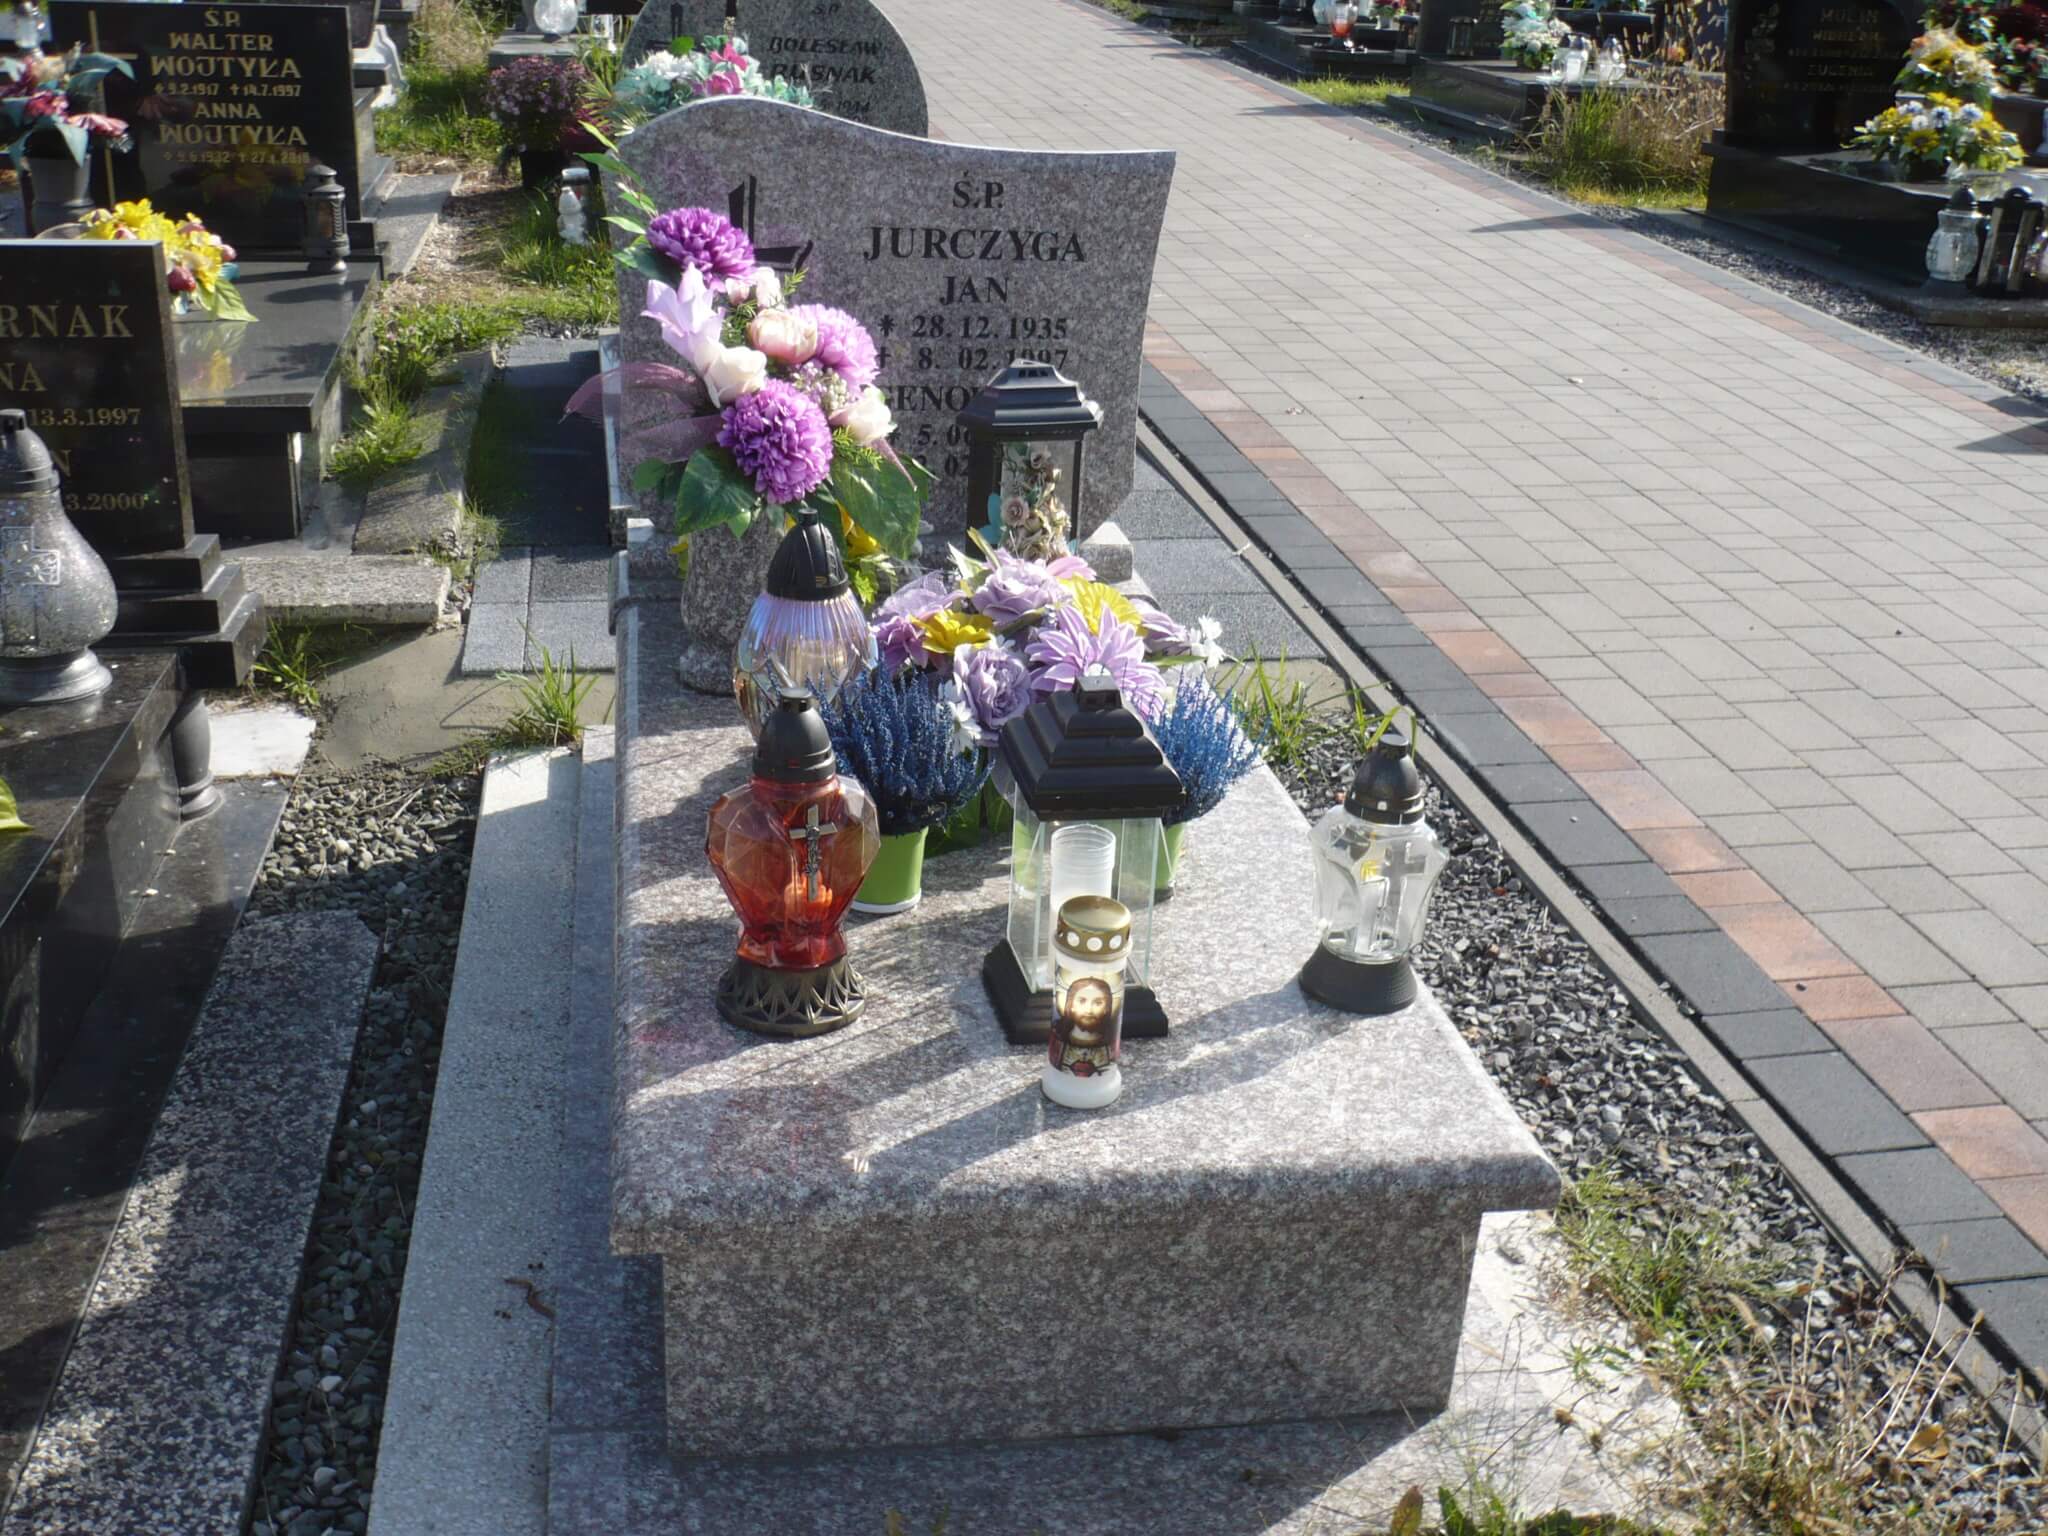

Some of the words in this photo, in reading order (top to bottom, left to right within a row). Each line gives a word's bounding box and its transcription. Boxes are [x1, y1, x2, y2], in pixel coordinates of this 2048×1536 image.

[168, 32, 273, 51] WALTER
[151, 55, 302, 78] WOJTYŁA
[194, 101, 262, 119] ANNA
[158, 124, 308, 146] WOJTYŁA
[863, 226, 1086, 262] JURCZYGA
[939, 275, 1009, 306] JAN
